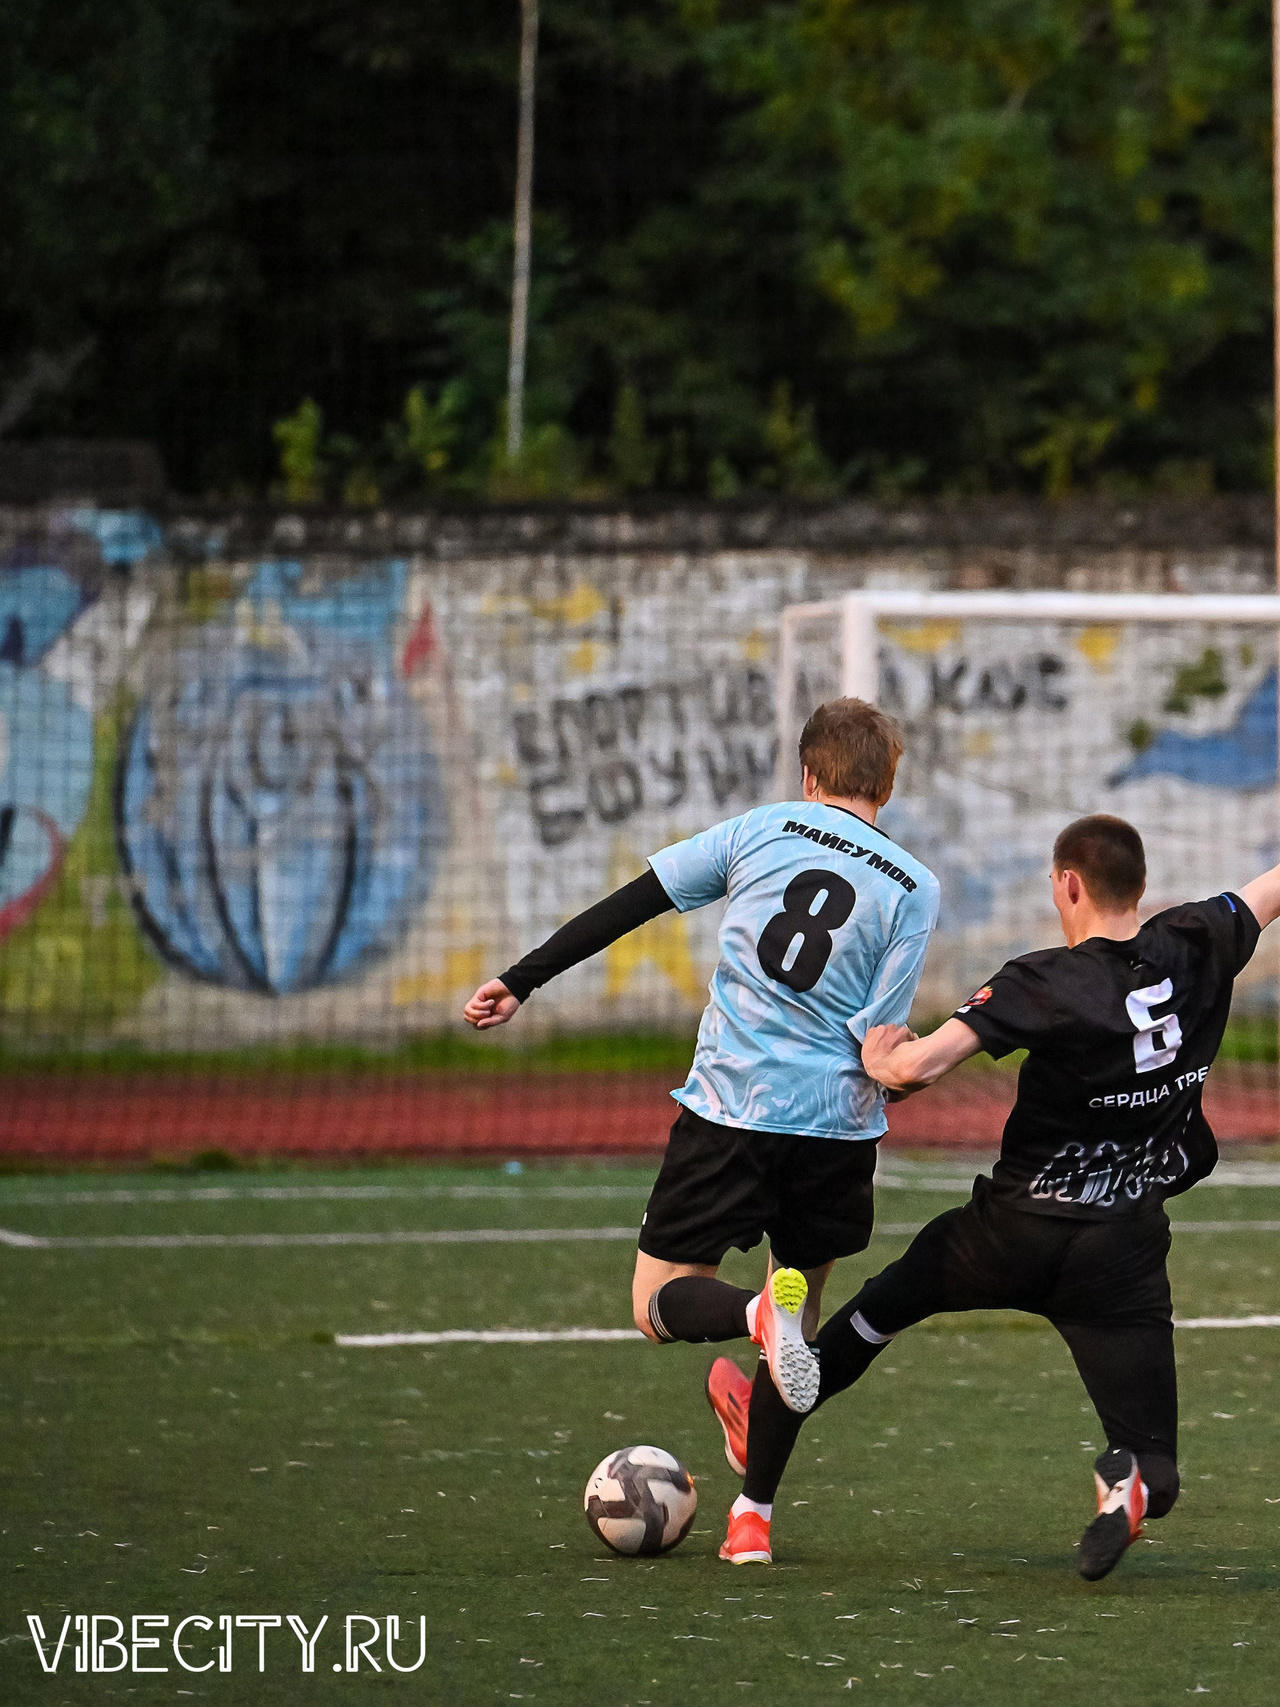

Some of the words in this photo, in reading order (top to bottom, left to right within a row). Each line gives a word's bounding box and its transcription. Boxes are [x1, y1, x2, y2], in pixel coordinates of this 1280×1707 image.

[781, 820, 918, 893] МАЙСУМОВ
[756, 868, 857, 993] 8
[1125, 977, 1183, 1074] 6
[1088, 1084, 1170, 1109] СЕРДЦА
[1174, 1065, 1209, 1091] ТРЕ
